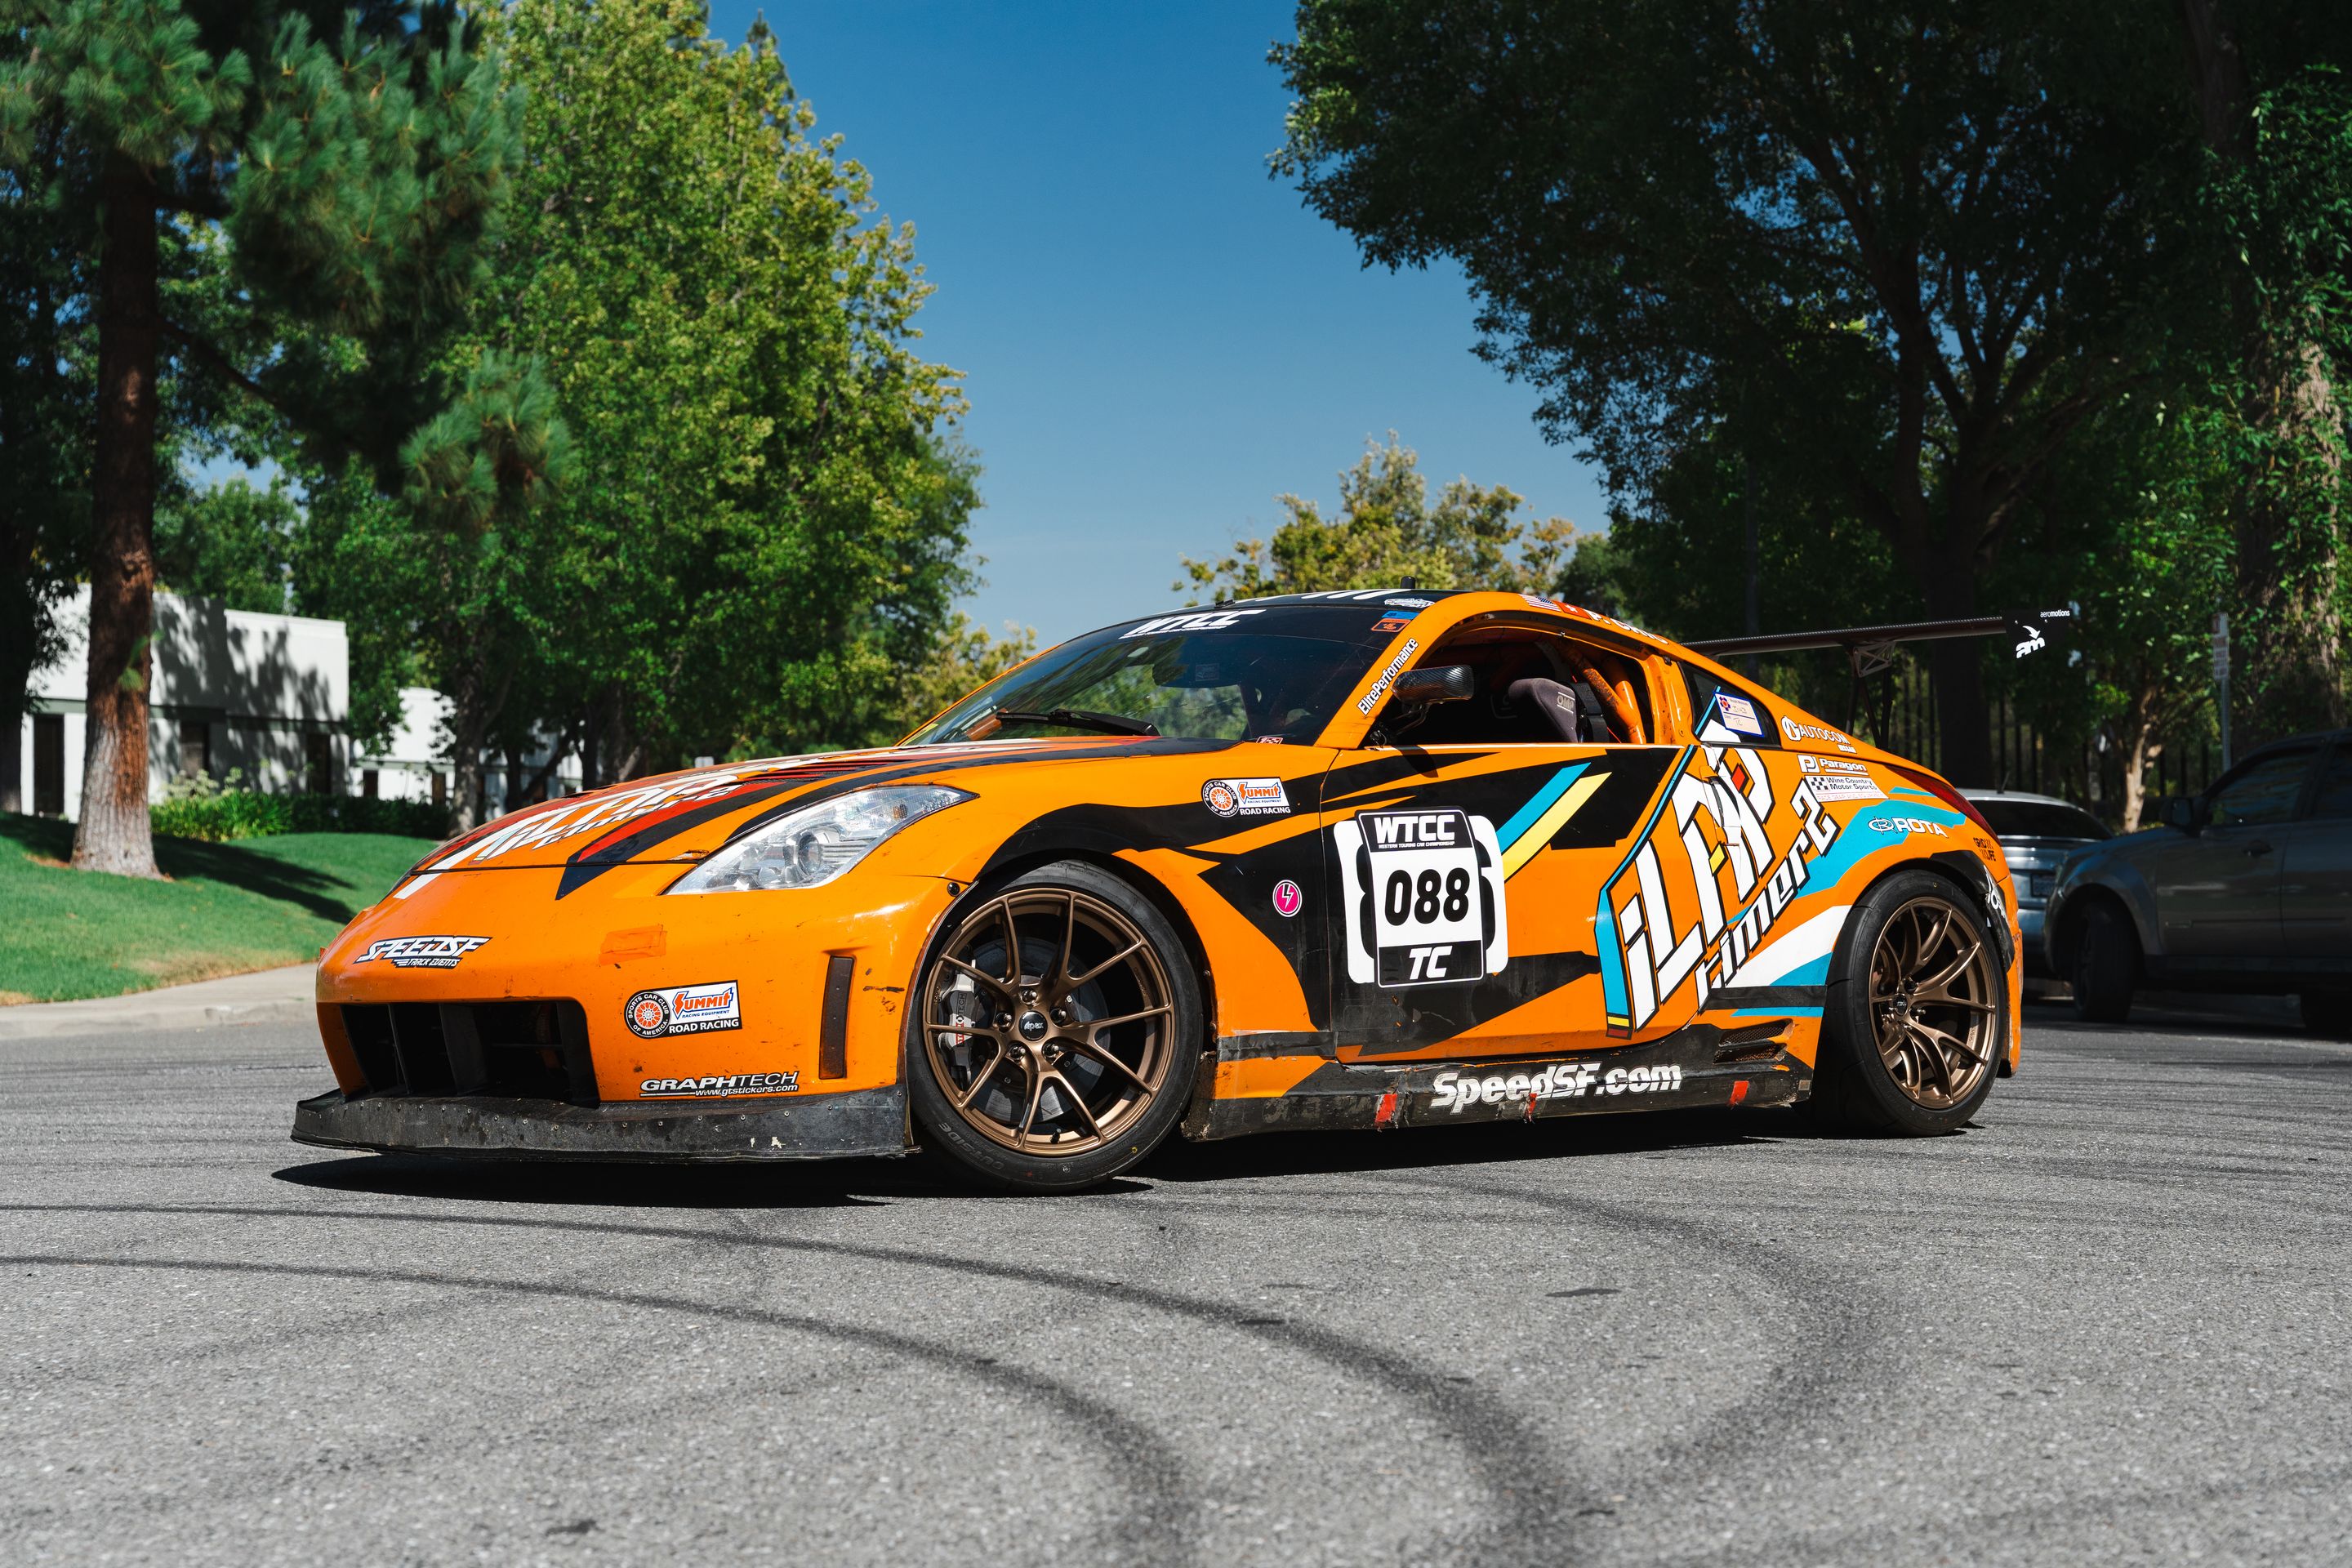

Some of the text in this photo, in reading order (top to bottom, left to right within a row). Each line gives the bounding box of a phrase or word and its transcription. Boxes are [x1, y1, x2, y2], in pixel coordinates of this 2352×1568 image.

[2040, 609, 2070, 617] aeromotions
[1123, 609, 1267, 637] WTCC
[1356, 638, 1419, 715] ElitePerformance
[1557, 695, 1575, 710] OMP
[1799, 724, 1851, 745] AUTOCOM
[1819, 758, 1868, 771] Paragon
[1846, 777, 1873, 786] Country
[1204, 783, 1214, 801] SPORTS
[1226, 786, 1237, 800] CLUB
[1240, 806, 1291, 815] ROAD RACING
[1374, 814, 1455, 844] WTCC
[1891, 817, 1949, 838] ROTA
[1384, 867, 1470, 926] 088
[355, 936, 492, 963] SPEEDSF
[408, 958, 461, 967] TRACK EVENTS
[1410, 945, 1453, 980] TC
[628, 996, 643, 1019] SPORTS
[657, 997, 670, 1015] CLUB
[702, 1009, 730, 1018] EQUIPMENT
[633, 1024, 642, 1032] OF
[669, 1018, 740, 1034] ROAD RACING
[641, 1071, 798, 1091] GRAPHTECH
[695, 1084, 798, 1097] www.gtstickers.com
[1431, 1062, 1682, 1115] SpeedSF.com
